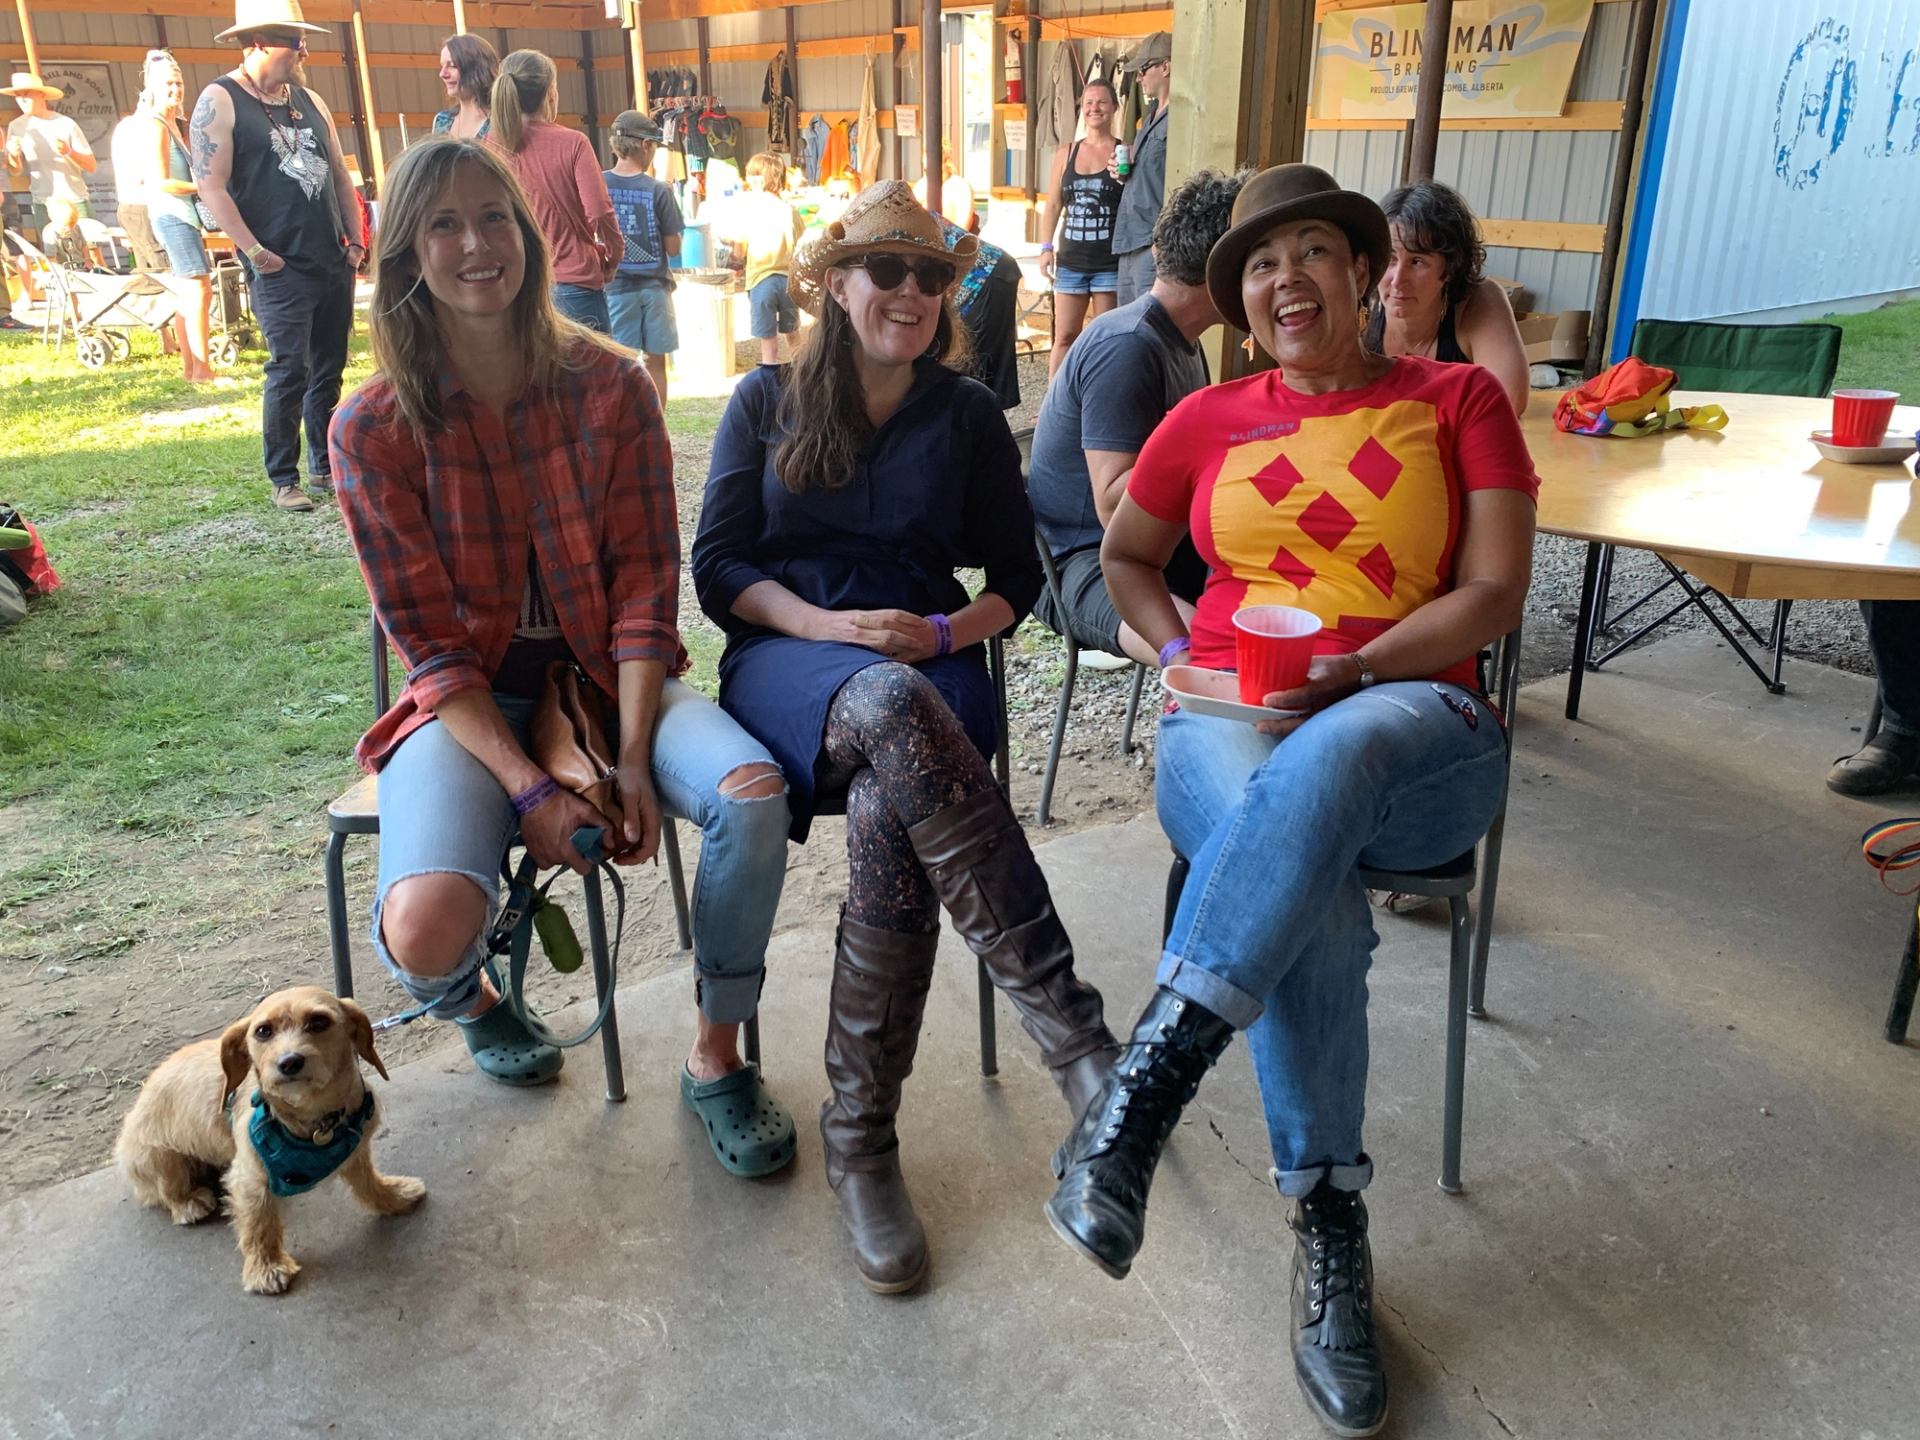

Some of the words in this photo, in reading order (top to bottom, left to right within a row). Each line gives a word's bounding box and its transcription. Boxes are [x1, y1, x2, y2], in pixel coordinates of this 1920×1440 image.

[1370, 23, 1518, 58] BLINMAN
[1394, 60, 1477, 76] BREING
[1396, 85, 1418, 93] BREWE
[1471, 82, 1504, 91] ALBERTA
[77, 100, 112, 115] Farm
